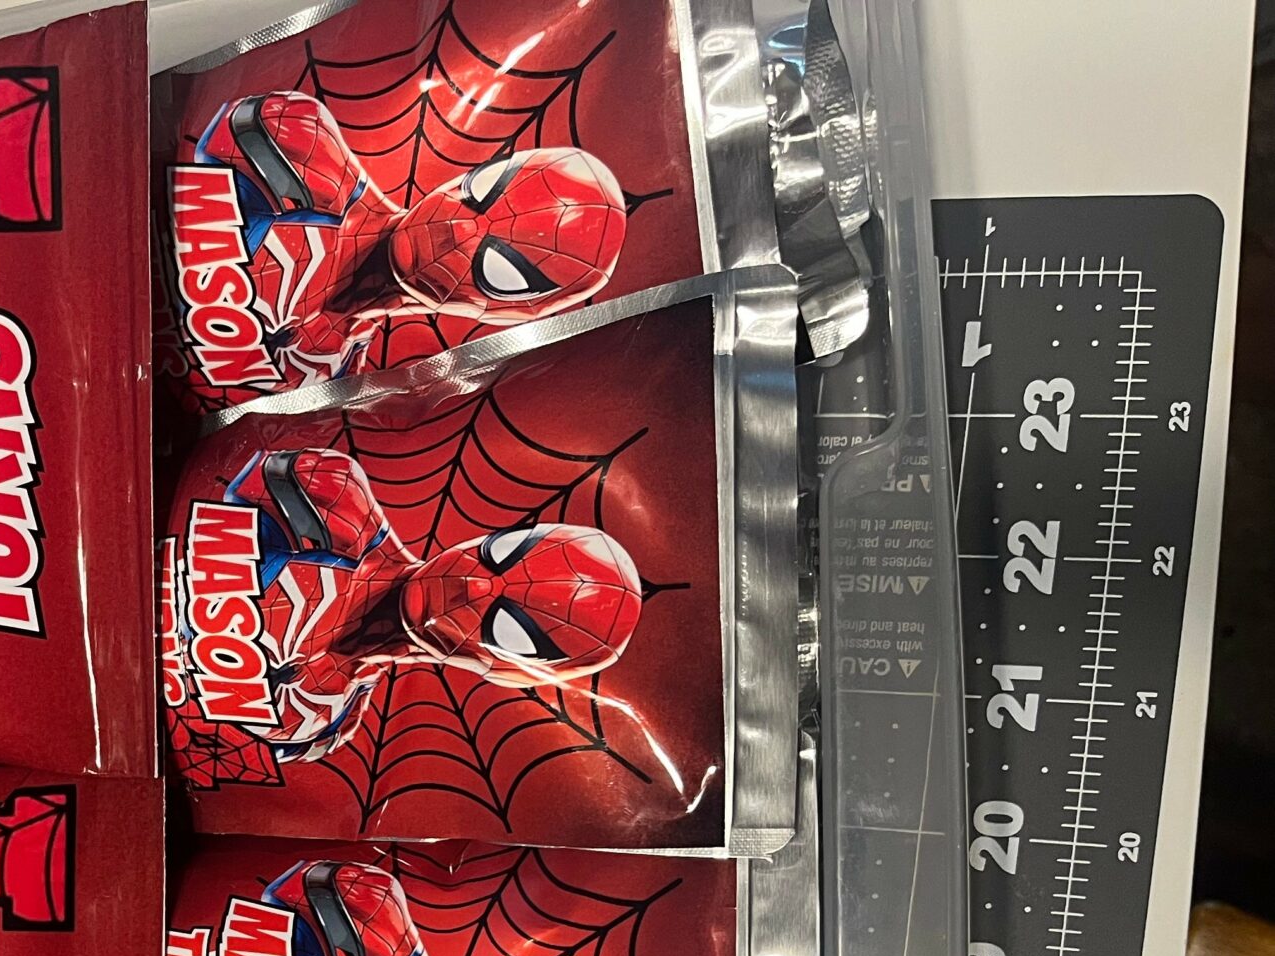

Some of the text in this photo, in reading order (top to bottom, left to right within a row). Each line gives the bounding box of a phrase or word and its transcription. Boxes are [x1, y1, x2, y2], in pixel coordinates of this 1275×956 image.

[985, 217, 996, 236] 1
[167, 166, 282, 386] MASON
[962, 321, 992, 367] 1
[1019, 377, 1075, 452] 23
[1168, 401, 1191, 431] 23
[1003, 520, 1060, 594] 22
[1152, 546, 1174, 576] 22
[188, 503, 279, 724] MASON
[986, 664, 1043, 731] 21
[1135, 691, 1158, 718] 21
[970, 800, 1024, 874] 20
[1118, 832, 1141, 863] 20
